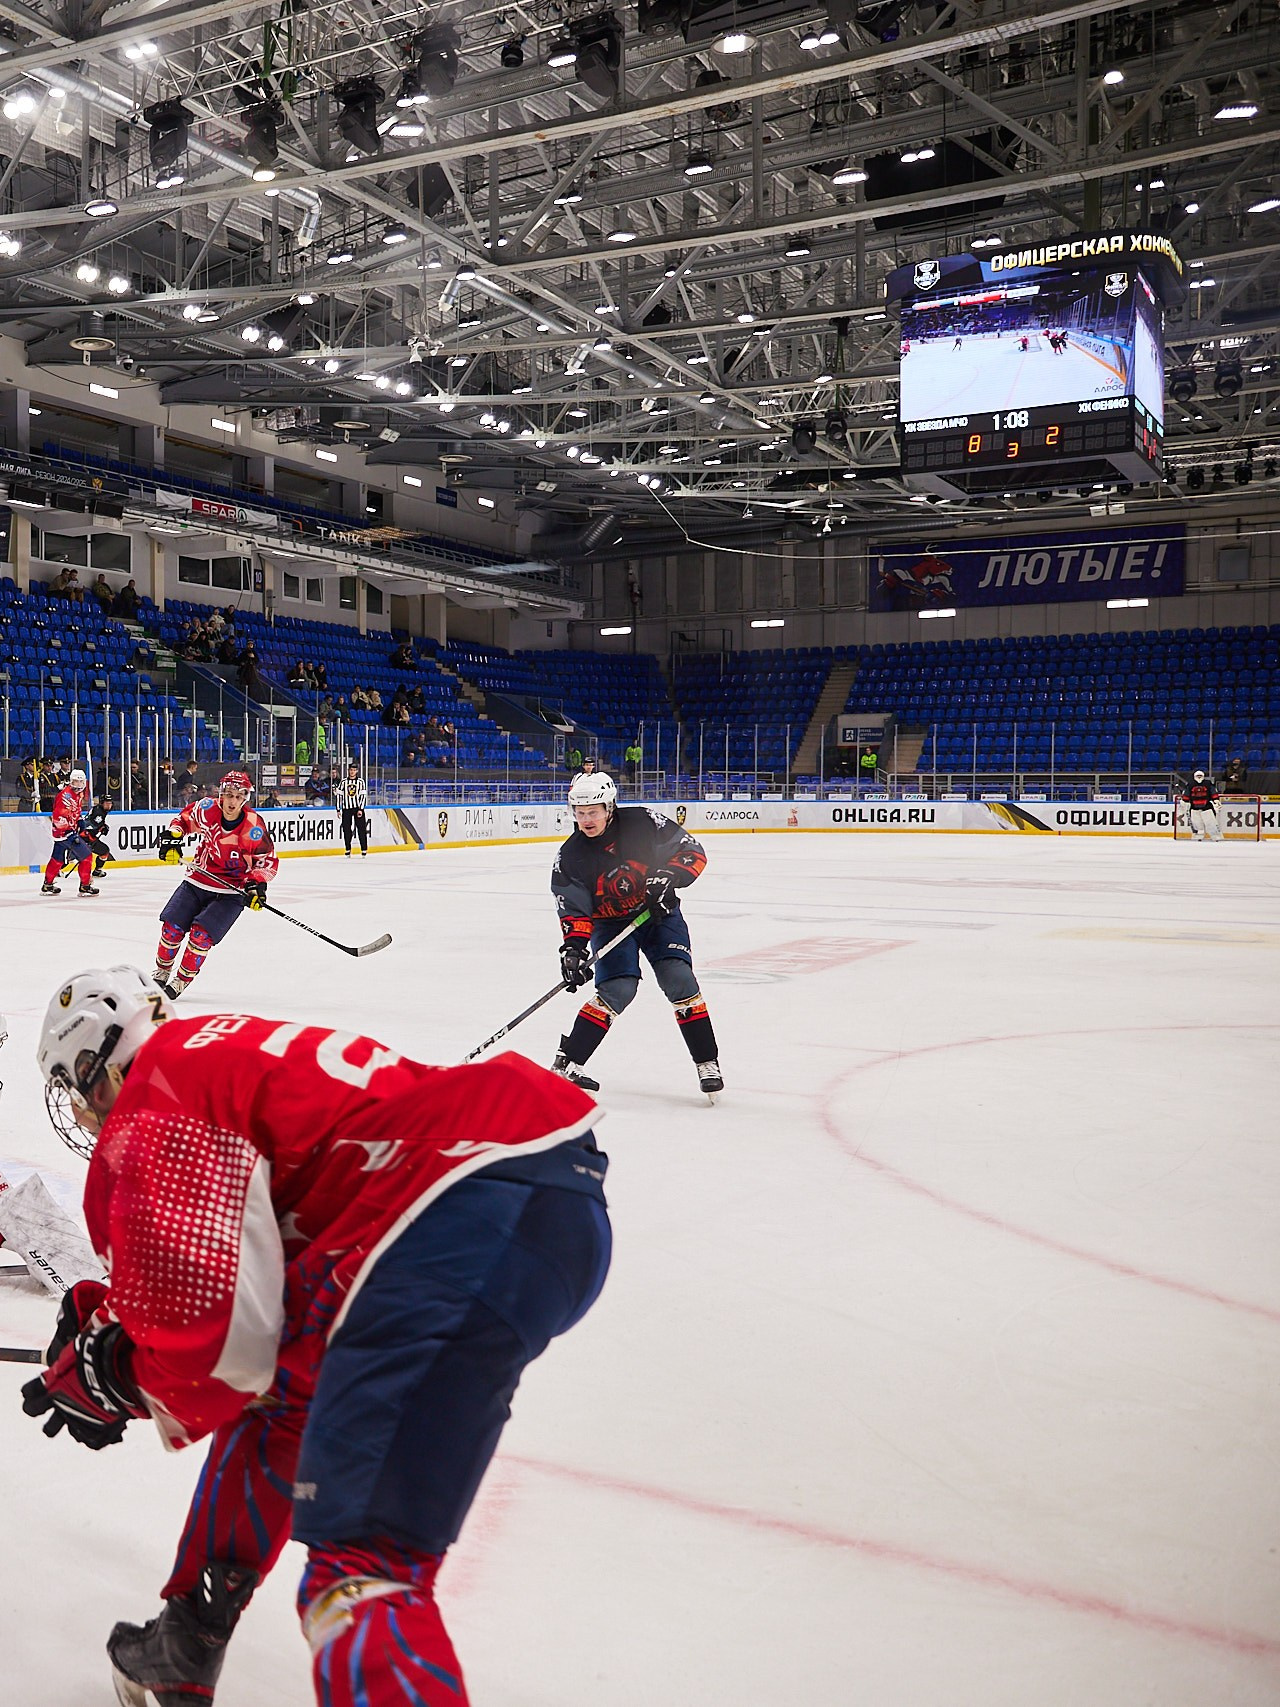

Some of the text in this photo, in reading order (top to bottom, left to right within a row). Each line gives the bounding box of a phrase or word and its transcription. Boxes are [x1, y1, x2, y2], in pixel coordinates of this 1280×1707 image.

[990, 235, 1124, 272] ОФИЦЕРСКАЯ
[992, 411, 1029, 431] 1:08
[968, 434, 981, 454] 8
[1046, 426, 1059, 446] 2
[1007, 442, 1018, 458] 3
[201, 503, 237, 520] SPAR
[978, 543, 1168, 589] ЛЮТЫЕ!
[255, 571, 262, 584] 10
[464, 809, 494, 825] ЛИГА
[832, 808, 935, 823] OHLIGA.RU
[1056, 810, 1192, 827] ОФИЦЕРСК
[267, 814, 334, 843] ККЕЙНАЯ
[667, 943, 691, 955] BAU
[58, 1015, 85, 1042] BAUER
[29, 1249, 69, 1293] BAUER
